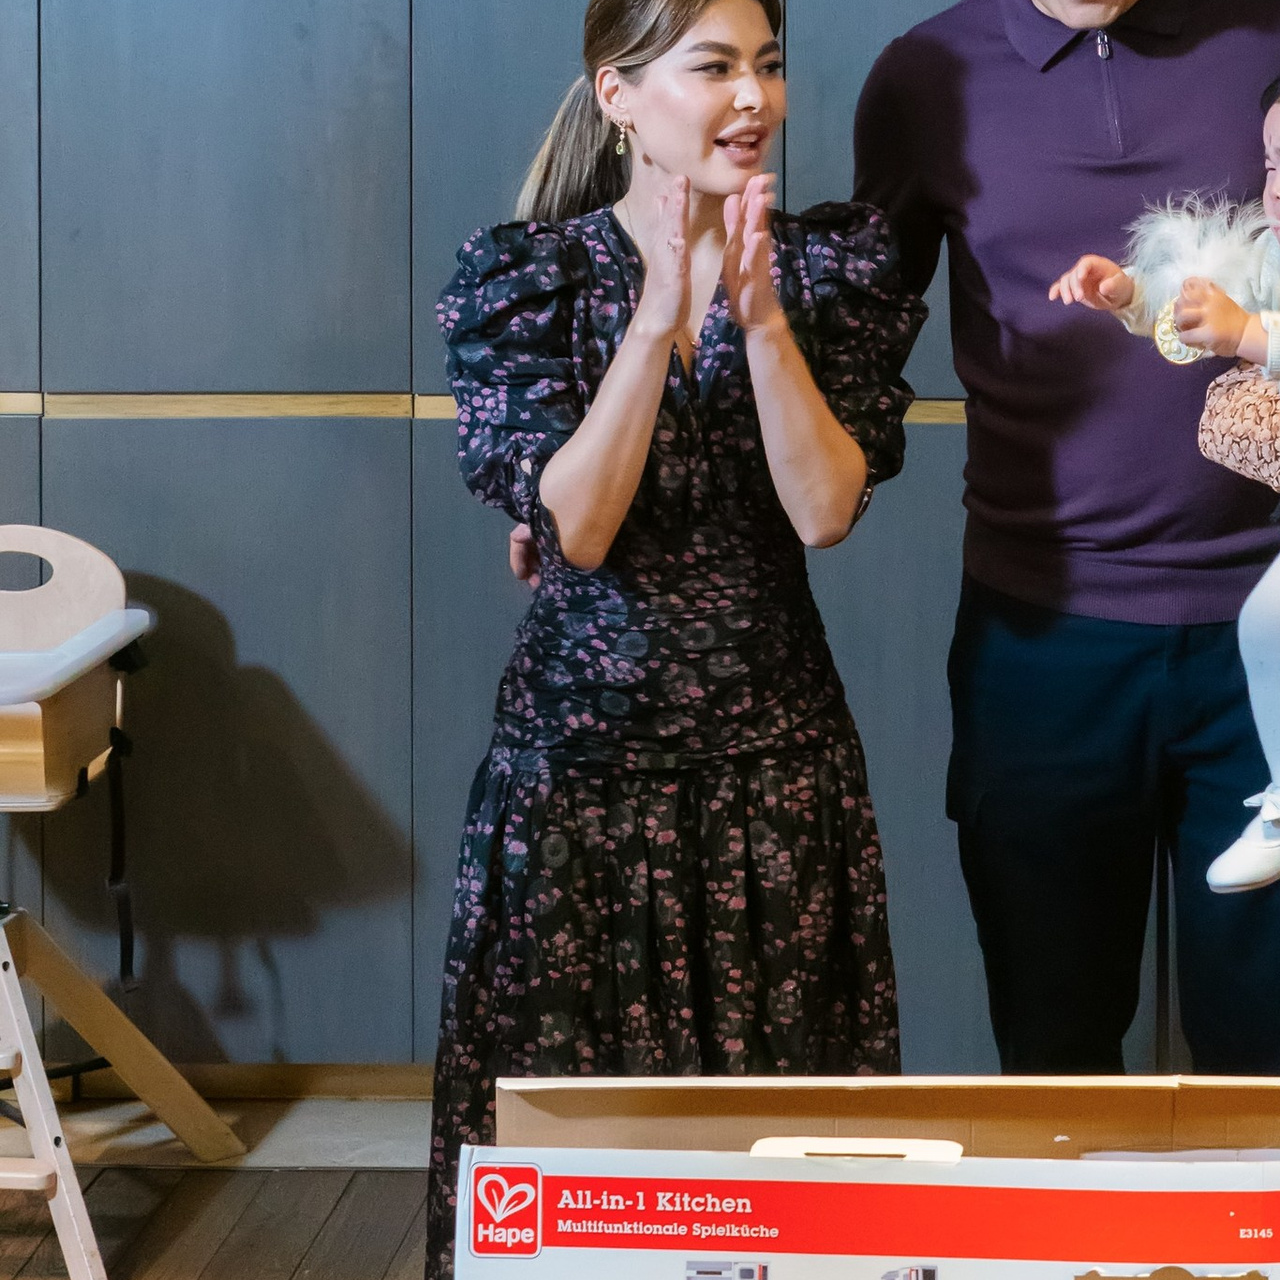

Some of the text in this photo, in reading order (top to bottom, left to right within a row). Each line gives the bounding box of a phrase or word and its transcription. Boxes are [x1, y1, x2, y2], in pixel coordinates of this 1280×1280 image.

[557, 1189, 752, 1214] All-in-1 Kitchen
[478, 1224, 534, 1247] Hape
[557, 1219, 779, 1239] Multifunktionale Spielküche
[1239, 1228, 1273, 1239] E3145
